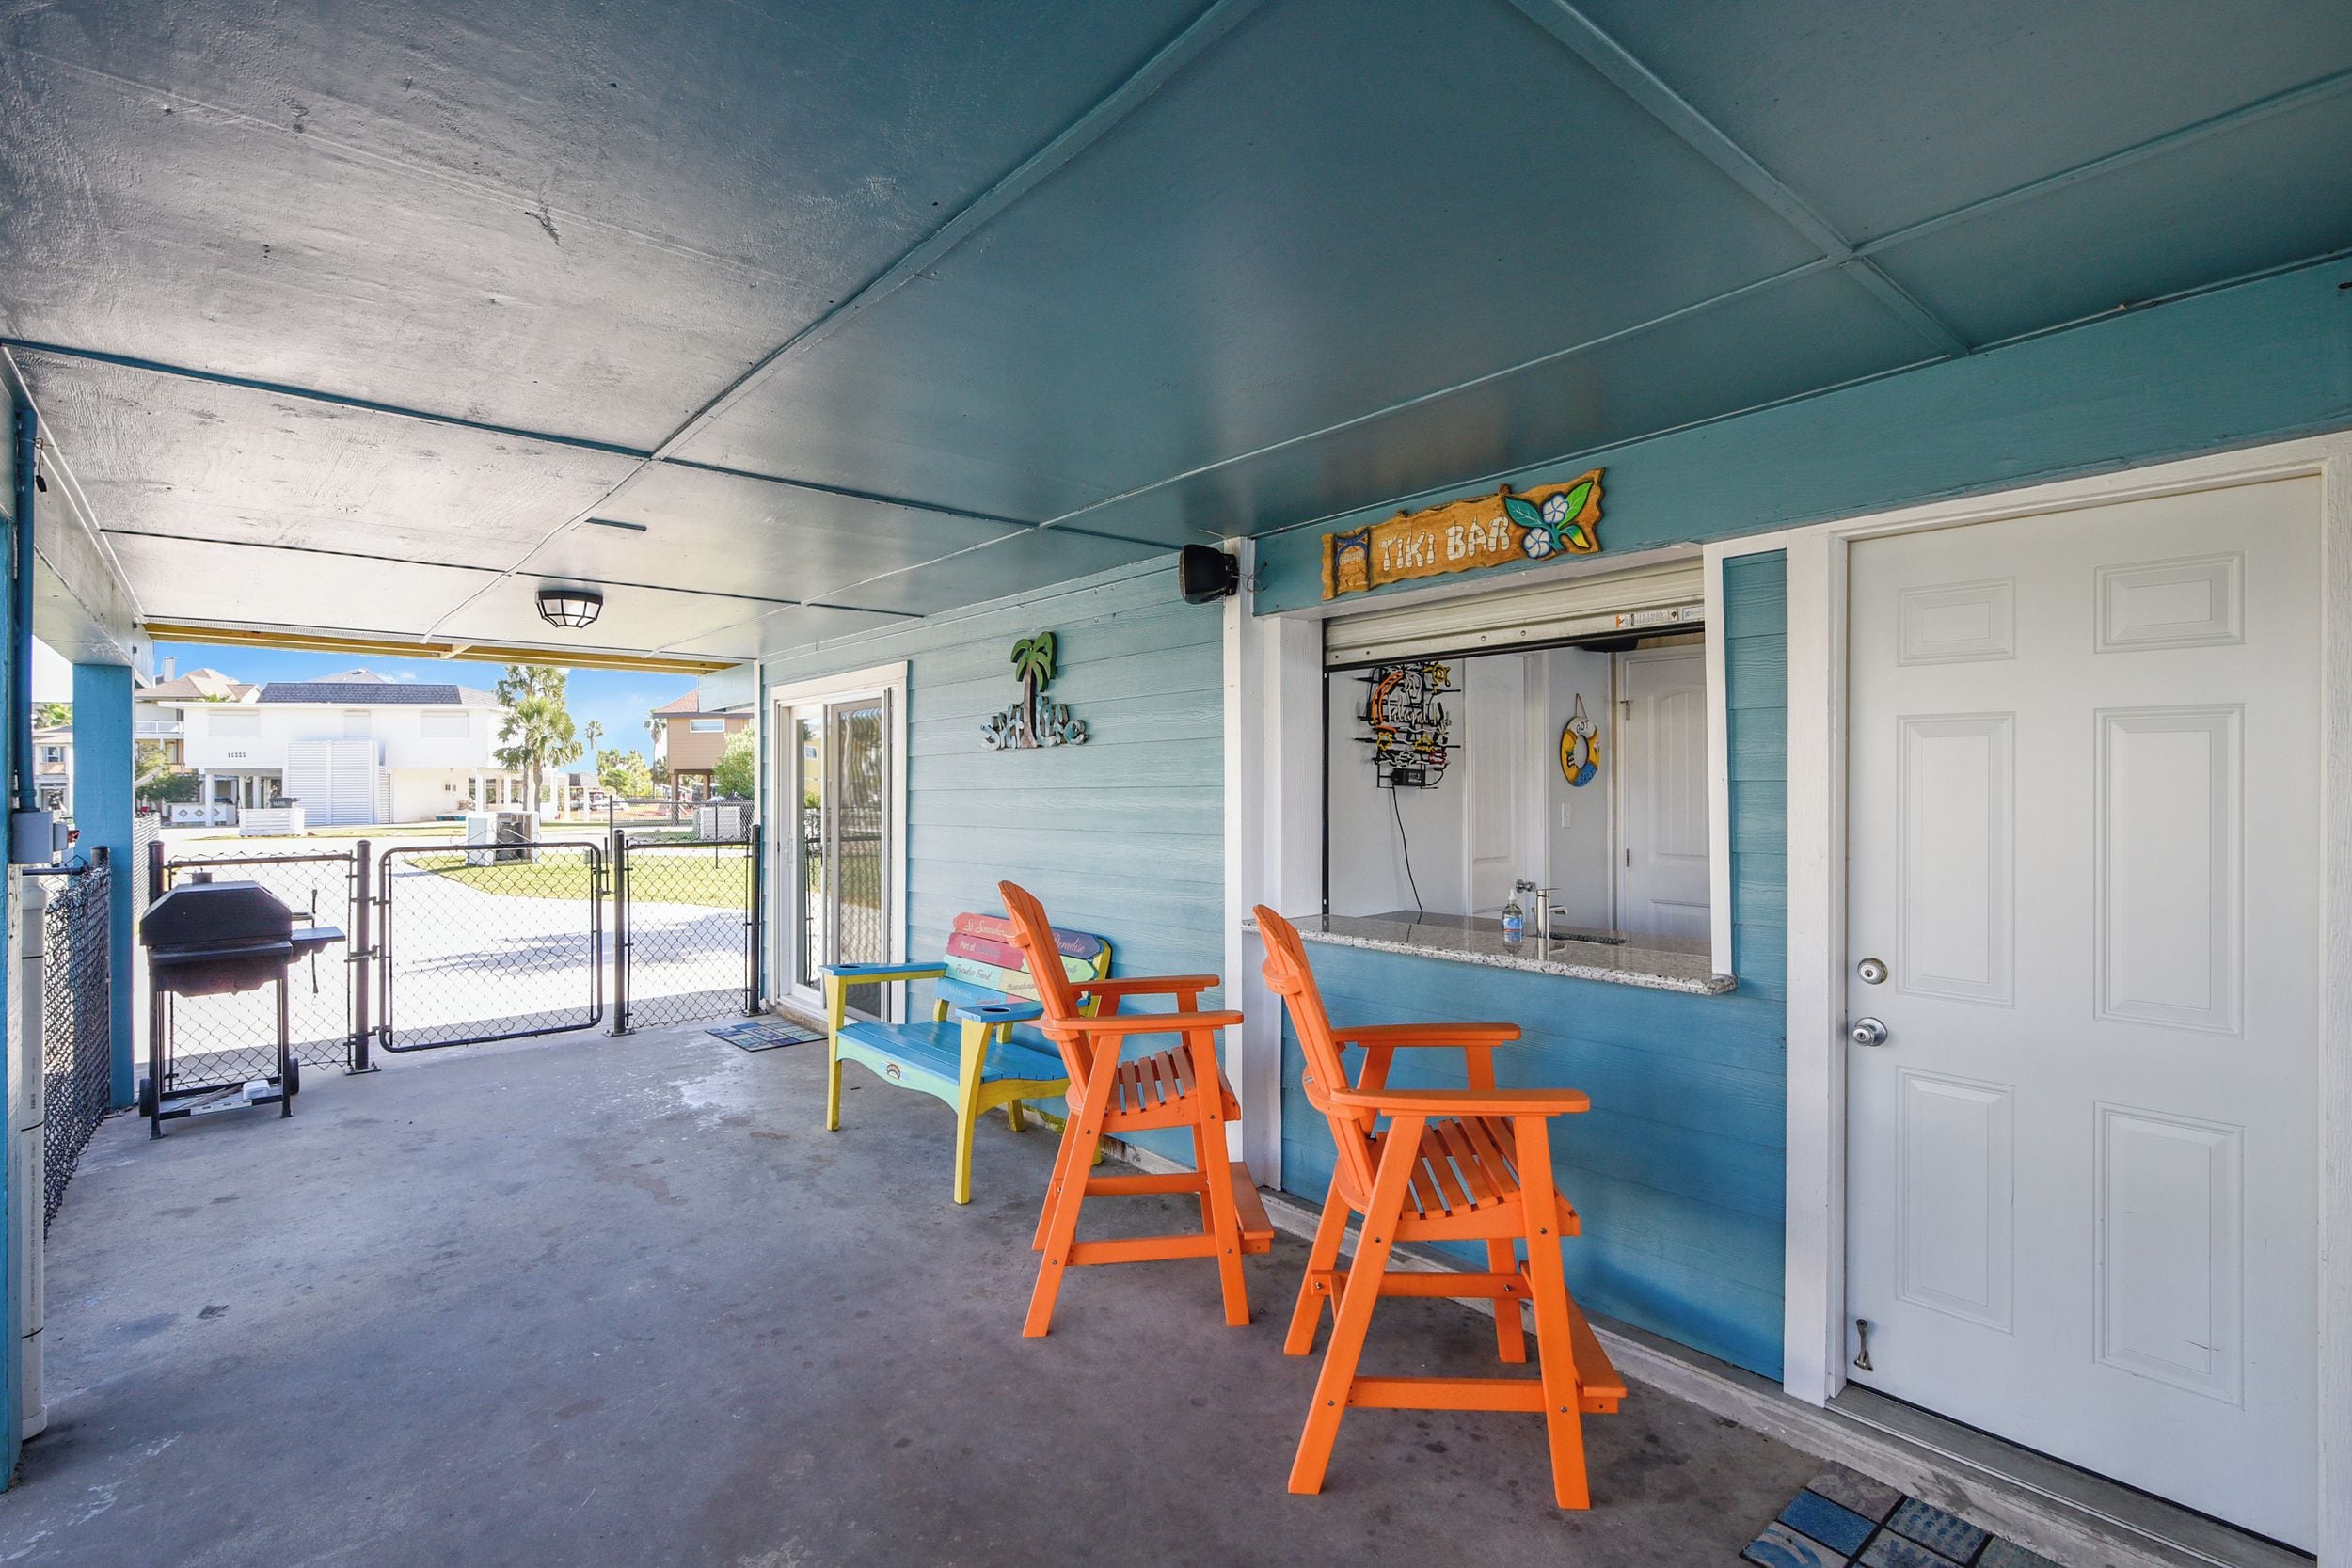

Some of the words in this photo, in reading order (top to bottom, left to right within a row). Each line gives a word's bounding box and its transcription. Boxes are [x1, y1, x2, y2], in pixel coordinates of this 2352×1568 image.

[1378, 531, 1436, 571] TIKI
[1445, 515, 1511, 561] BAR
[1577, 720, 1588, 734] GOT
[1053, 933, 1085, 953] Paradise
[975, 970, 993, 980] Found
